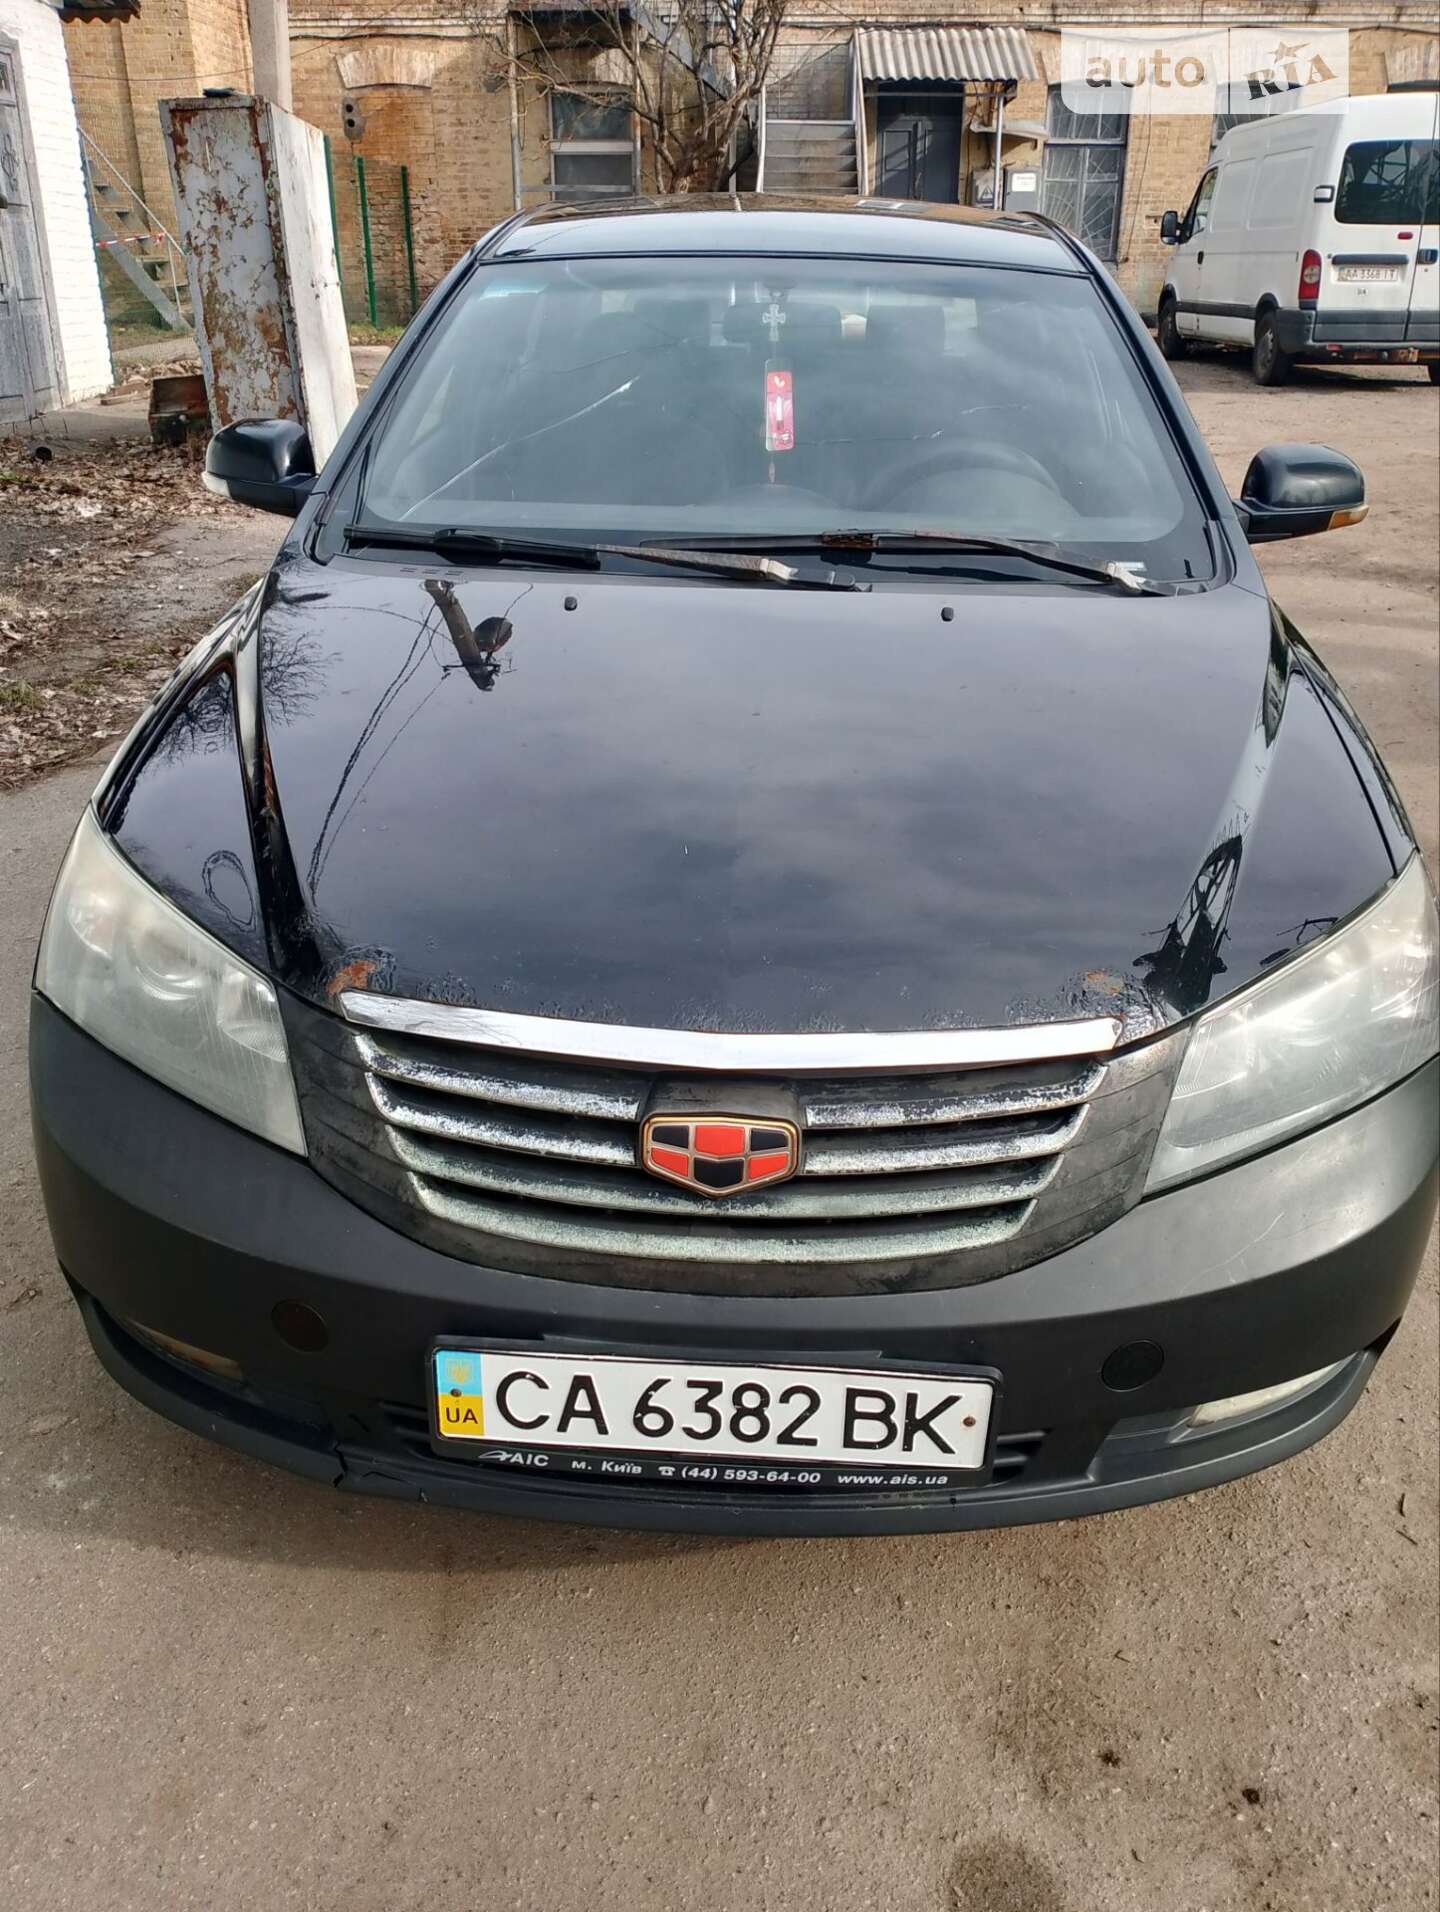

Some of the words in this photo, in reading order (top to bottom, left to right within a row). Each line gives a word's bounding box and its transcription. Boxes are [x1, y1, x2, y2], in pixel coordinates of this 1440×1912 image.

[445, 1406, 479, 1425] UA
[496, 1370, 610, 1435] CA
[632, 1377, 820, 1448] 6382
[842, 1387, 963, 1455] BK
[571, 1460, 593, 1471] м.
[601, 1460, 643, 1475] Київ
[681, 1465, 719, 1480] (44)
[723, 1468, 822, 1484] 593-64-00
[837, 1473, 949, 1486] www.ais.ua
